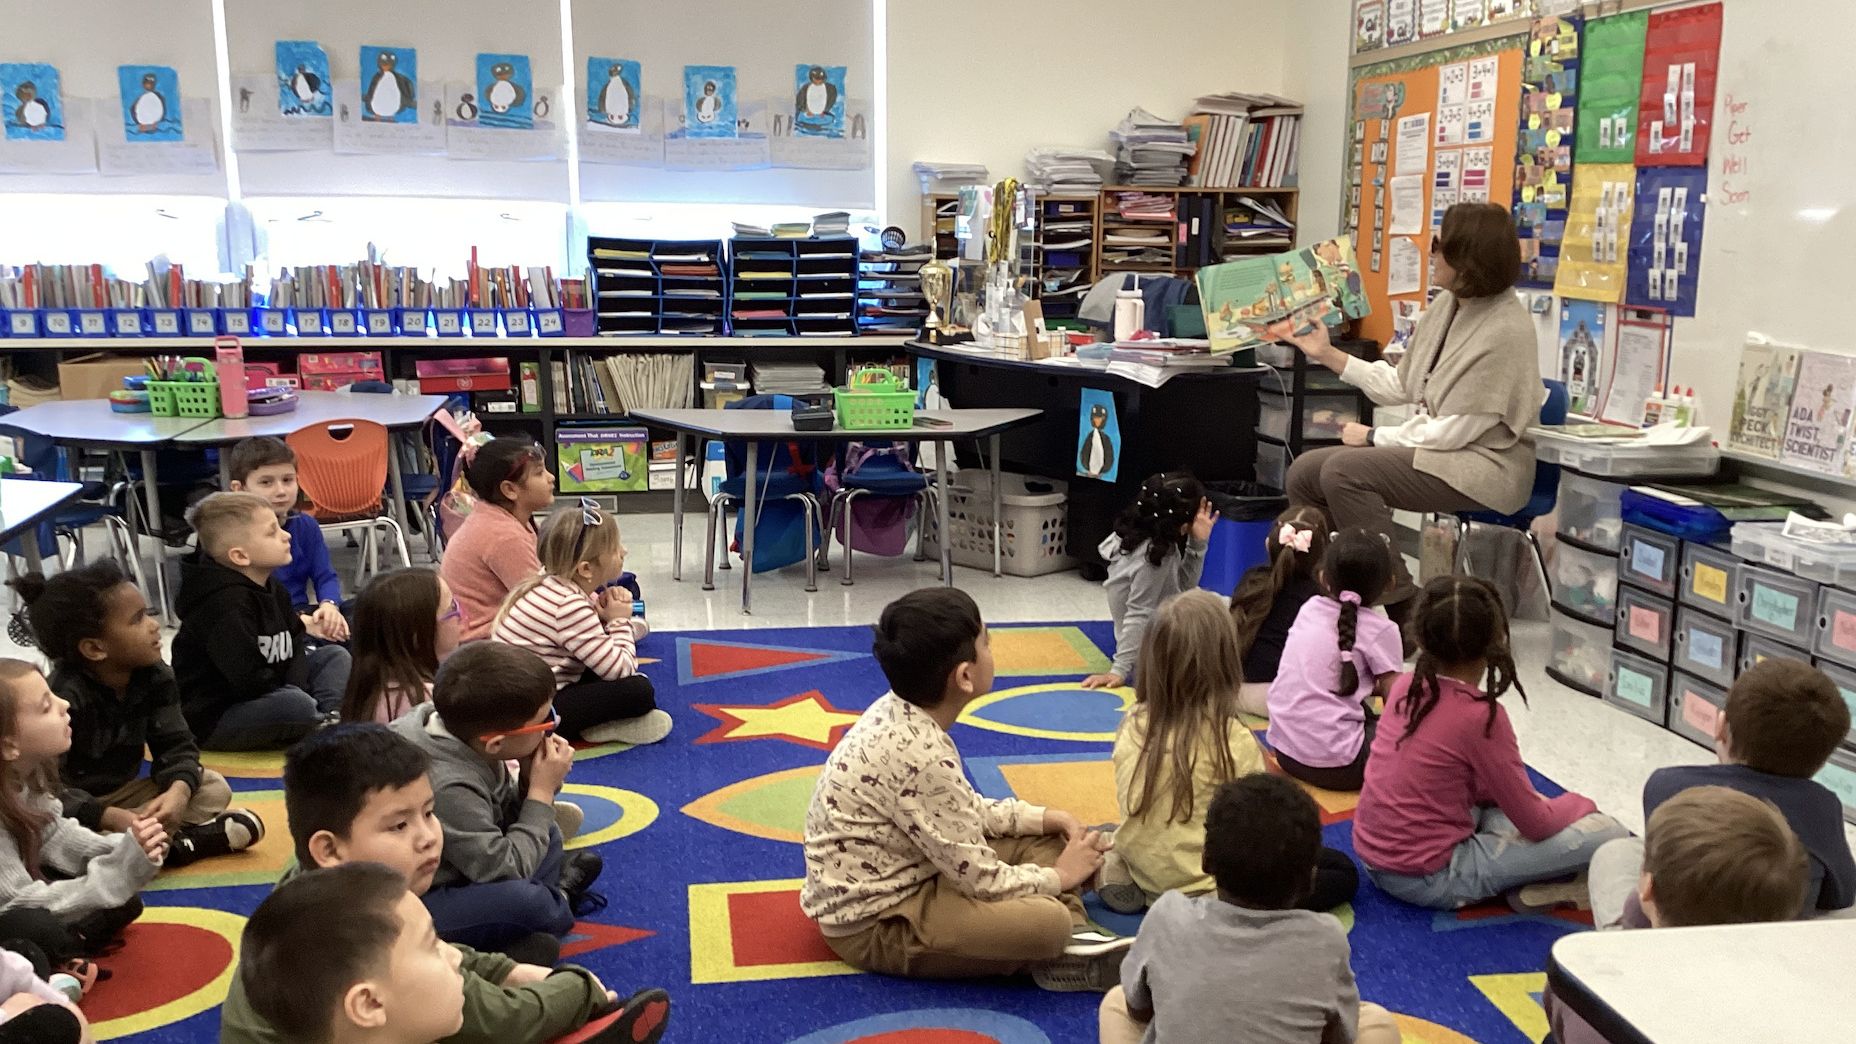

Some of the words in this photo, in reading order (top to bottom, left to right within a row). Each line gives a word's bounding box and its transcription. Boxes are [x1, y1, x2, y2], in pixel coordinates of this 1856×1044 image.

[1728, 120, 1752, 145] Get
[1720, 180, 1749, 206] Soon
[232, 318, 243, 327] 15
[267, 317, 279, 326] 16
[304, 318, 315, 327] 17
[338, 318, 349, 327] 18
[374, 318, 386, 327] 19
[407, 317, 421, 326] 20
[443, 318, 454, 327] 21
[478, 318, 491, 327] 22
[511, 318, 524, 327] 23
[544, 318, 556, 327] 24
[1793, 407, 1813, 422] ADA
[1785, 439, 1838, 462] SCIENTIST
